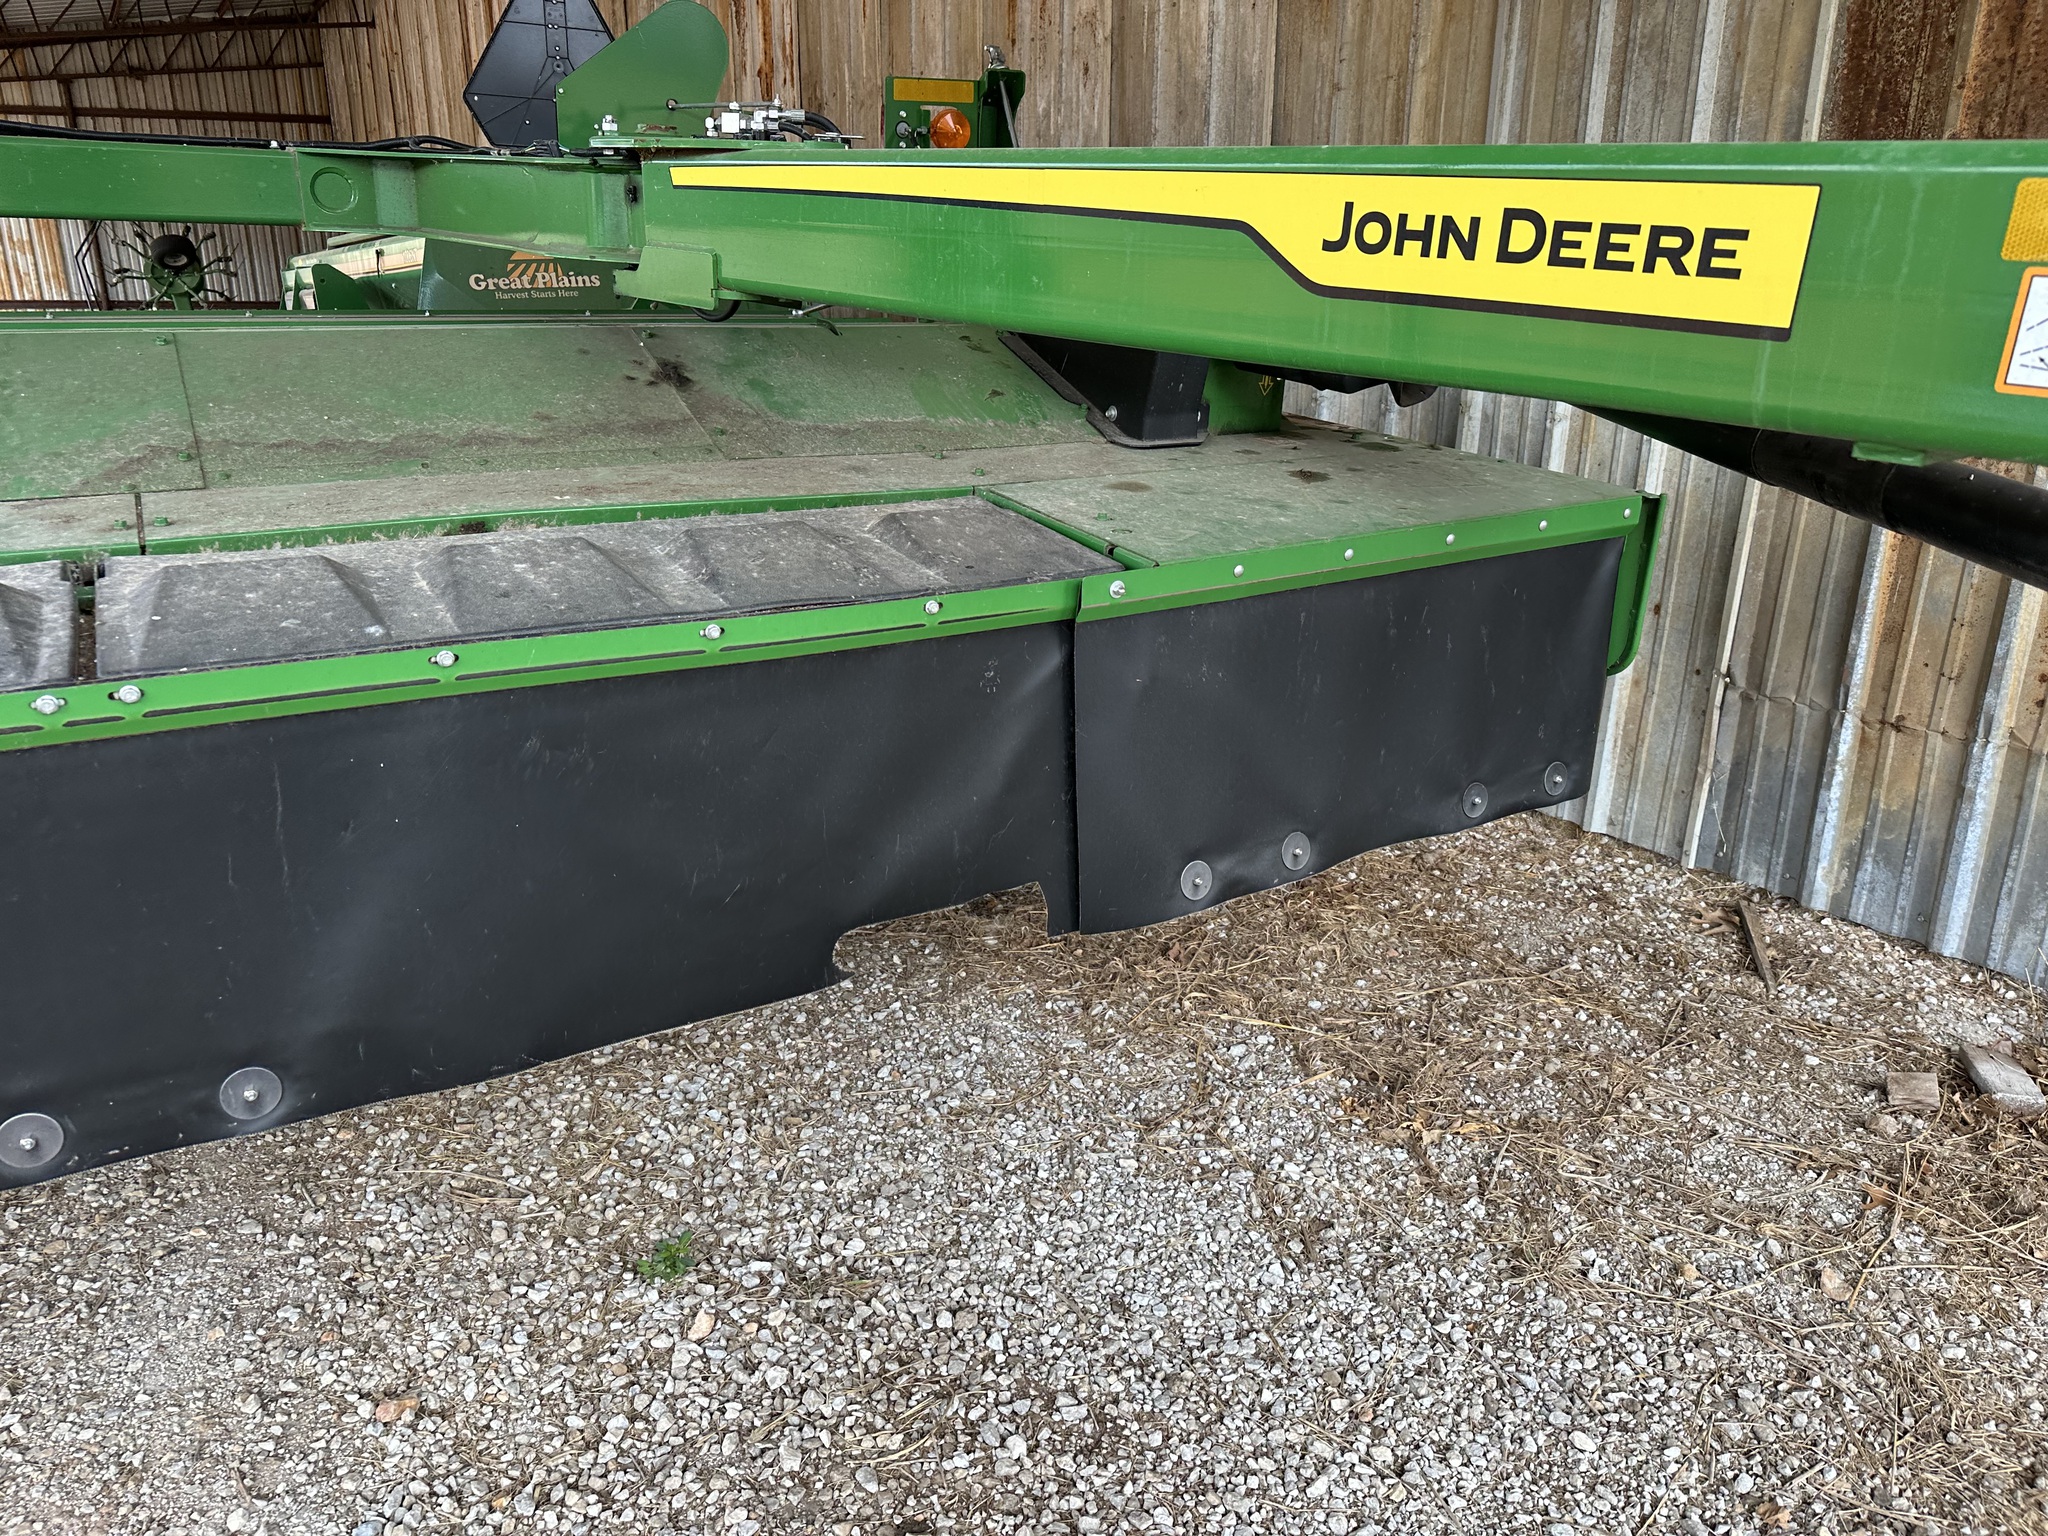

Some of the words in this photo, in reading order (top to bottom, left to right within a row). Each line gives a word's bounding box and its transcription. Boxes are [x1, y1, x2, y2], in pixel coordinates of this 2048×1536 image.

[1321, 201, 1481, 261] JOHN
[1495, 207, 1750, 280] DEERE
[468, 273, 533, 291] Great
[535, 271, 601, 288] Plains
[495, 291, 529, 300] Harvest
[530, 290, 556, 299] Starts
[557, 289, 579, 298] Here
